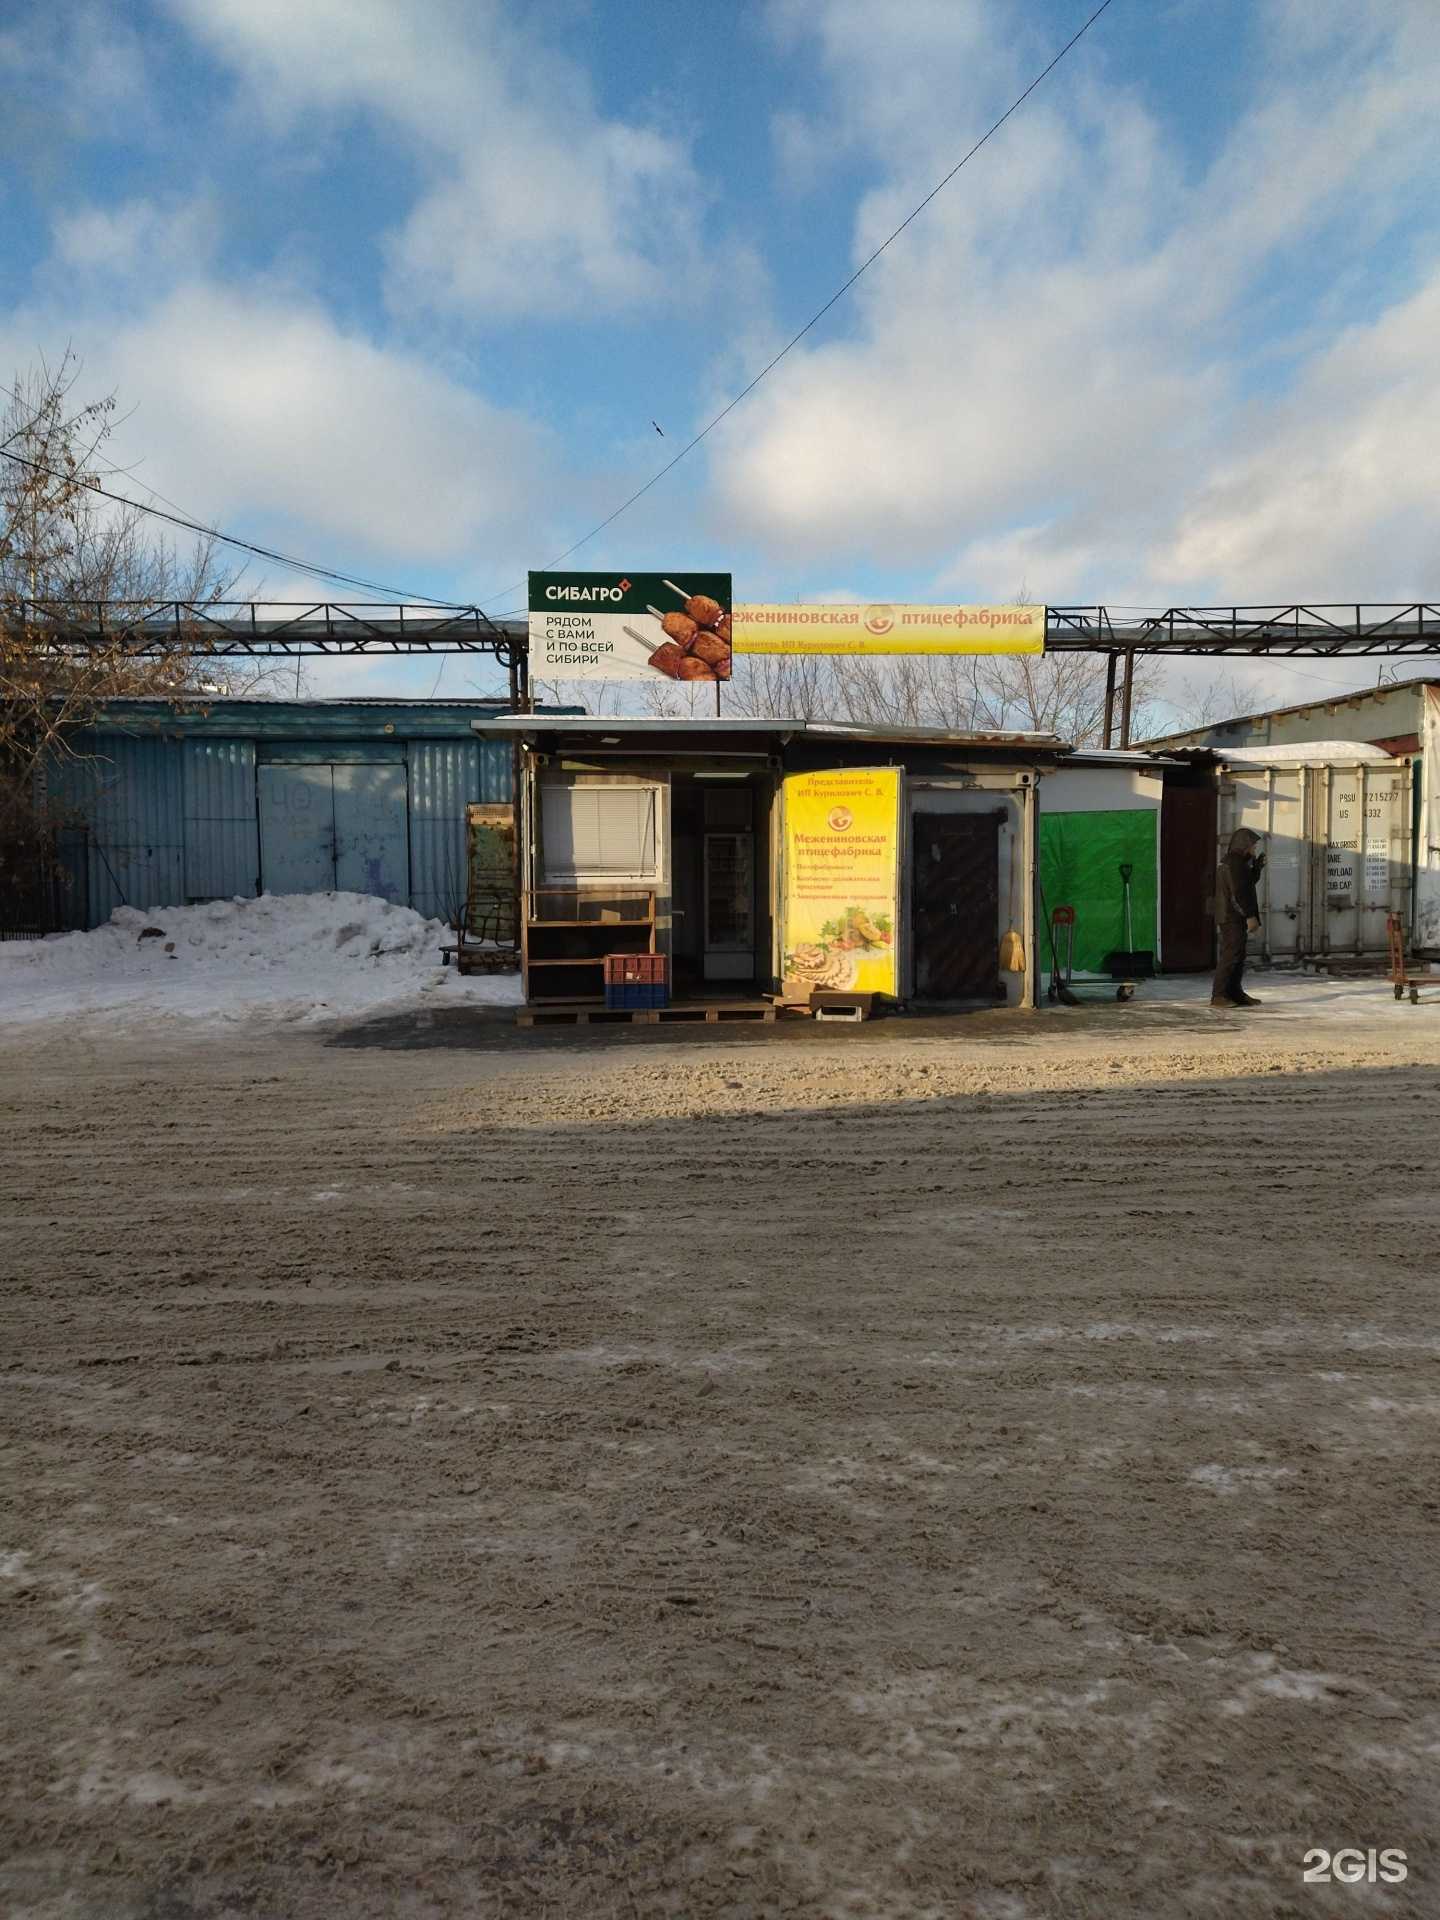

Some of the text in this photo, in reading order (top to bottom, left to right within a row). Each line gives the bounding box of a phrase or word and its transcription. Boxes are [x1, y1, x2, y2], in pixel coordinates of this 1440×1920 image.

[545, 586, 623, 602] СИБАГРО
[546, 616, 592, 628] РЯДОМ
[732, 609, 1033, 628] ежениновская птицефабрика
[546, 629, 595, 640] С ВАМИ
[546, 641, 614, 652] И ПО ВСЕЙ
[546, 654, 599, 664] СИБИРИ
[1339, 809, 1349, 819] US
[794, 833, 887, 844] Межениновская
[797, 845, 882, 859] птицефабрика
